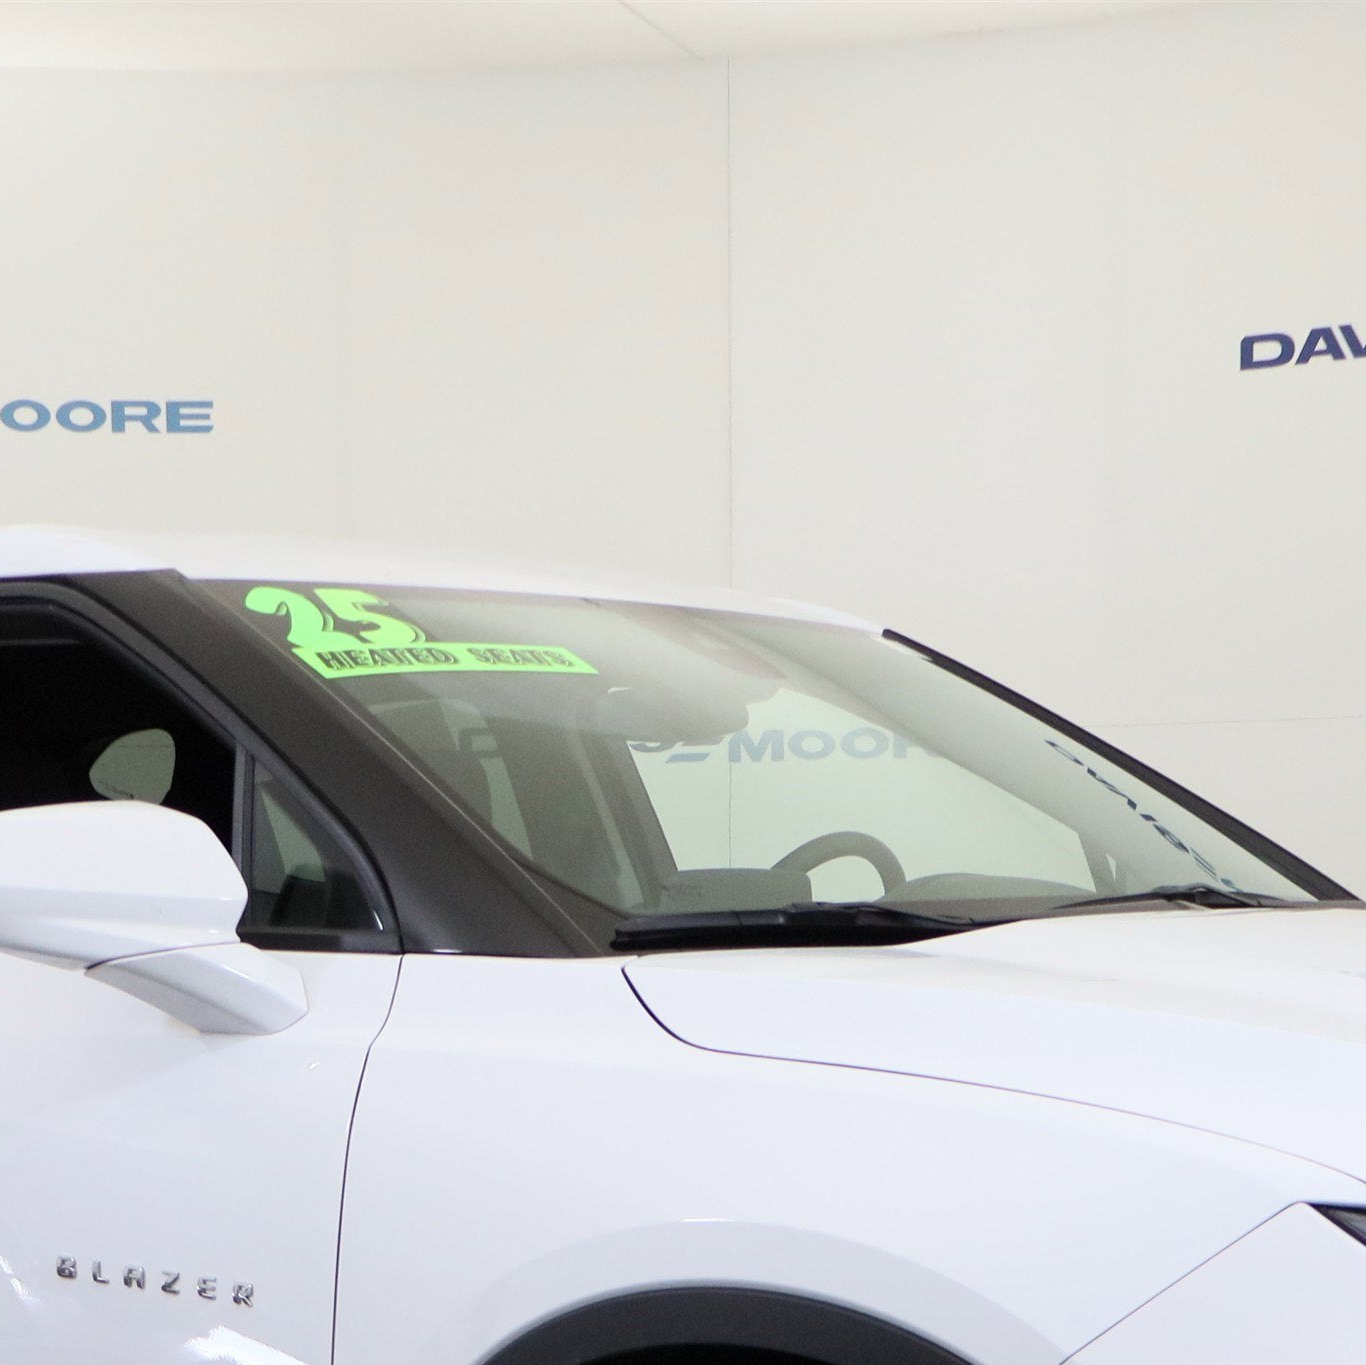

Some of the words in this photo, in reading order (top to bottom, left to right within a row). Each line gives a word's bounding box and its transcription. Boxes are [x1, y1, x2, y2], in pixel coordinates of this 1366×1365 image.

[244, 586, 427, 647] 25
[315, 647, 460, 671] HEATED
[466, 648, 575, 668] SEATS
[728, 727, 919, 763] MOO
[55, 1255, 254, 1308] BLAZER
